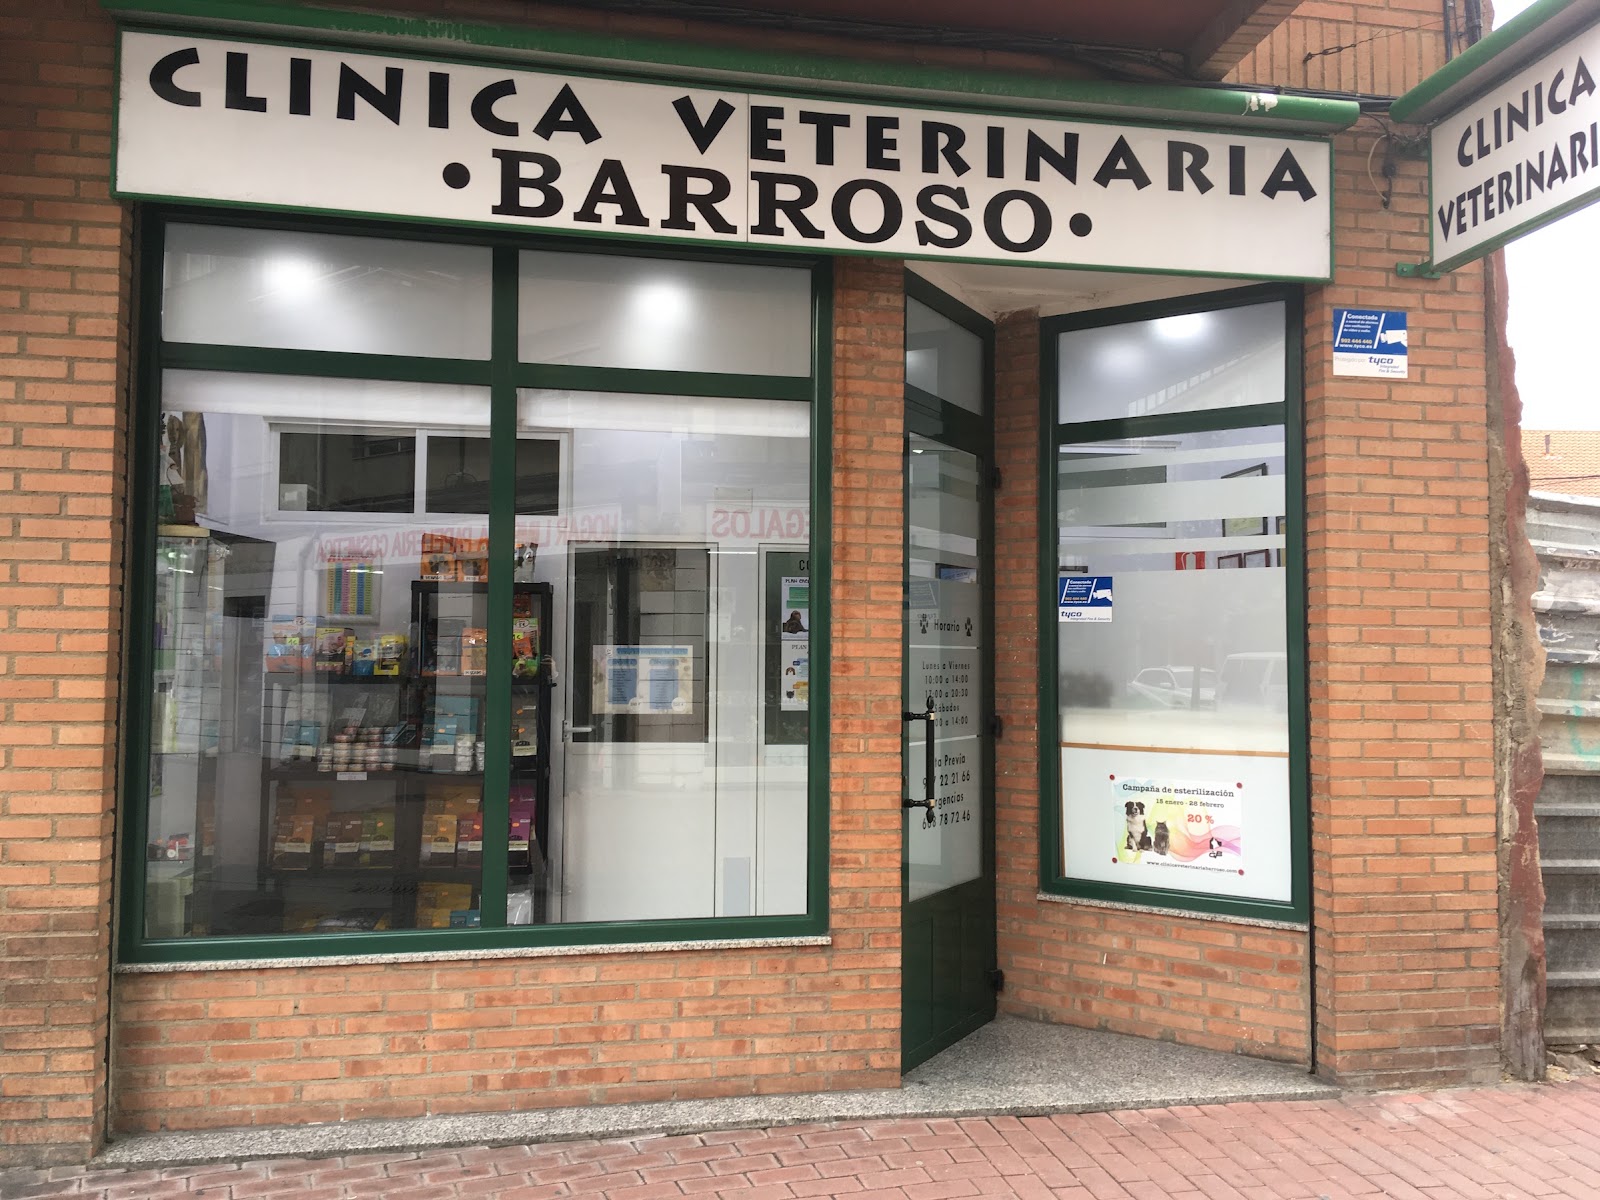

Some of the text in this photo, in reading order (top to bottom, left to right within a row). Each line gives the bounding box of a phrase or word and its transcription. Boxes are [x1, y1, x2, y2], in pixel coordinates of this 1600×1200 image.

[1457, 56, 1597, 168] CLINICA
[149, 47, 1317, 203] CLINICA VETERINARIA
[491, 149, 1053, 254] BARROSO
[1368, 356, 1394, 365] tyco
[934, 619, 960, 632] Horario
[922, 661, 939, 670] Lunes
[949, 661, 970, 670] Viernes
[925, 675, 943, 684] 10:00
[952, 675, 968, 683] 14:00
[952, 688, 968, 698] 20:30
[952, 716, 968, 725] 14:00
[944, 753, 966, 766] Previa
[940, 774, 948, 786] 22
[952, 772, 958, 784] 21
[962, 770, 970, 782] 66
[1122, 784, 1160, 793] Campaña
[1174, 787, 1234, 797] esterilización
[935, 792, 964, 809] rgencias
[940, 813, 948, 825] 78
[951, 811, 959, 823] 72
[962, 810, 970, 821] 46
[1187, 814, 1214, 824] 20 %
